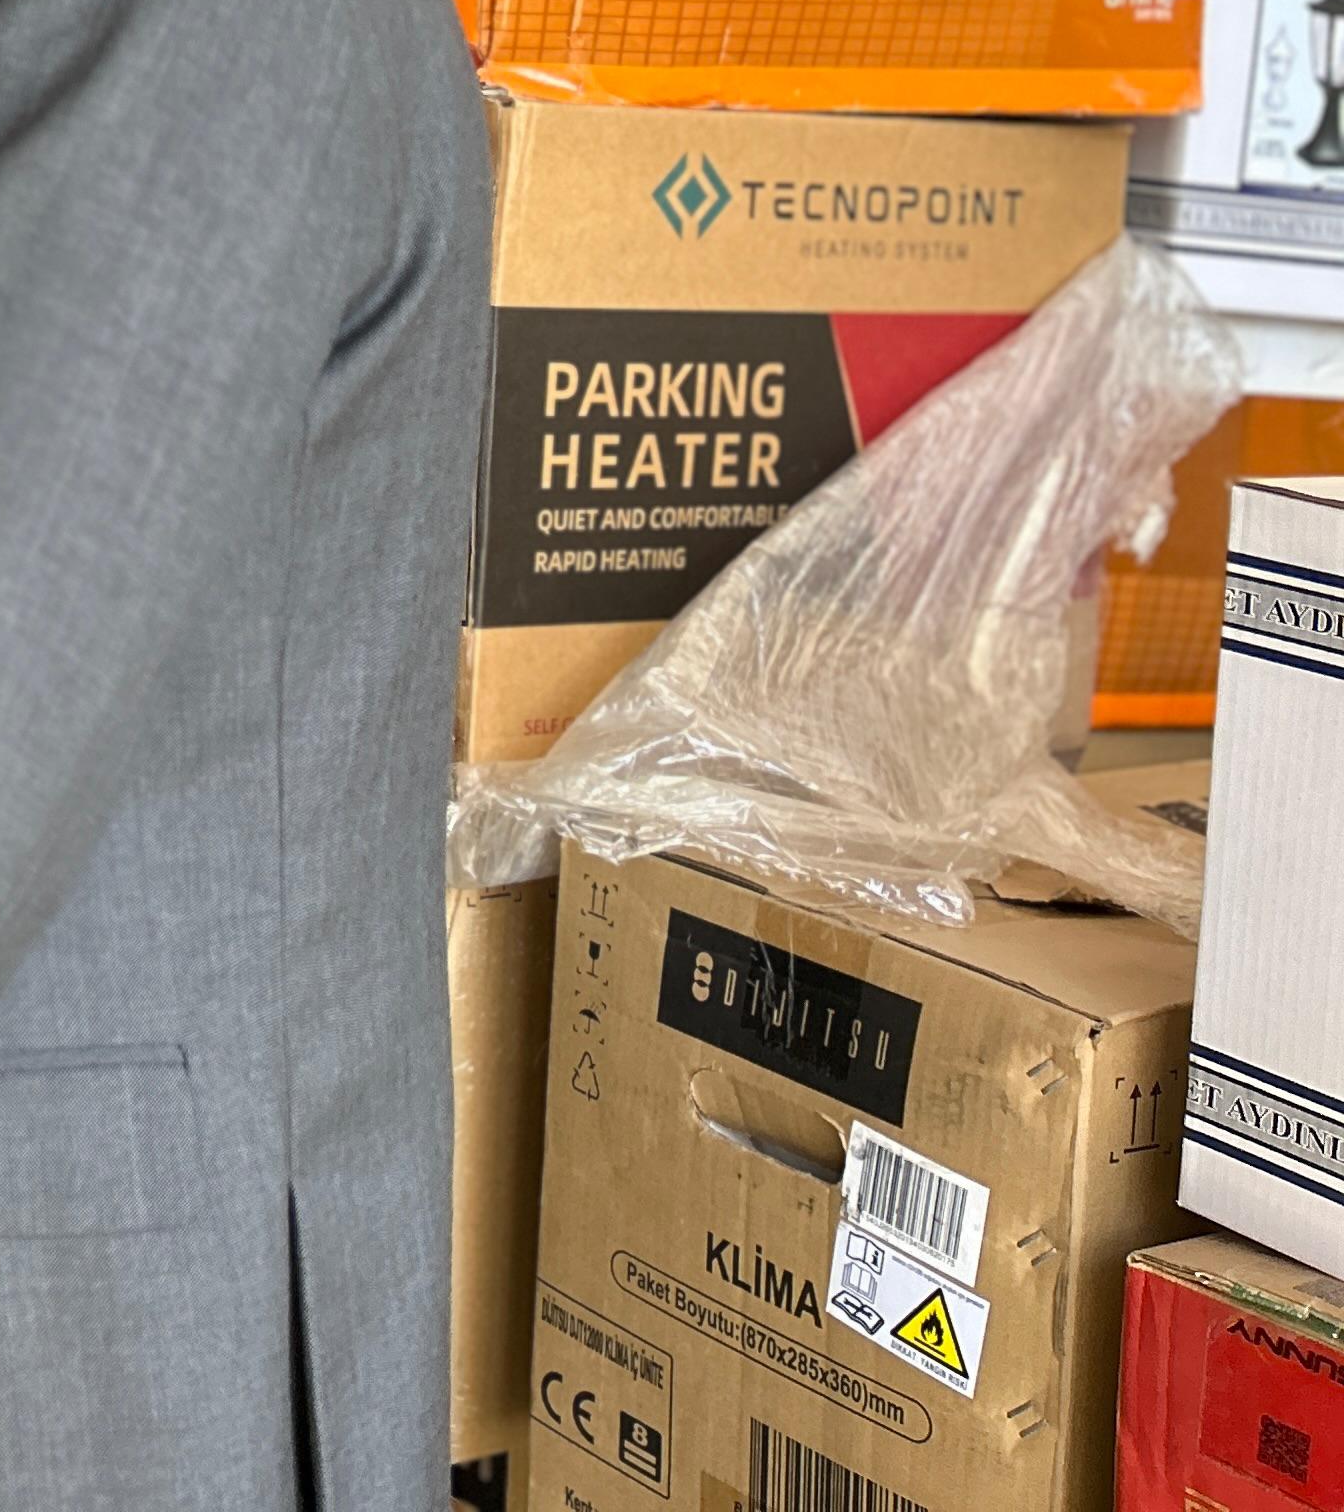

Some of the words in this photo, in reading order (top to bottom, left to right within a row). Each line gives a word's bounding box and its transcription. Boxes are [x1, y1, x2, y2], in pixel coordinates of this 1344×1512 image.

[800, 240, 887, 260] HEATING
[894, 241, 969, 261] SYSTEM
[543, 361, 787, 420] PARKING
[540, 432, 782, 491] HEATER
[536, 509, 600, 534] QUIET
[601, 508, 646, 530] AND
[533, 551, 597, 574] RAPID
[599, 547, 687, 572] HEATING
[523, 717, 559, 736] SELF
[723, 967, 890, 1072] DIJITSU
[626, 1260, 672, 1306] Paket
[705, 1230, 823, 1330] KLİMA
